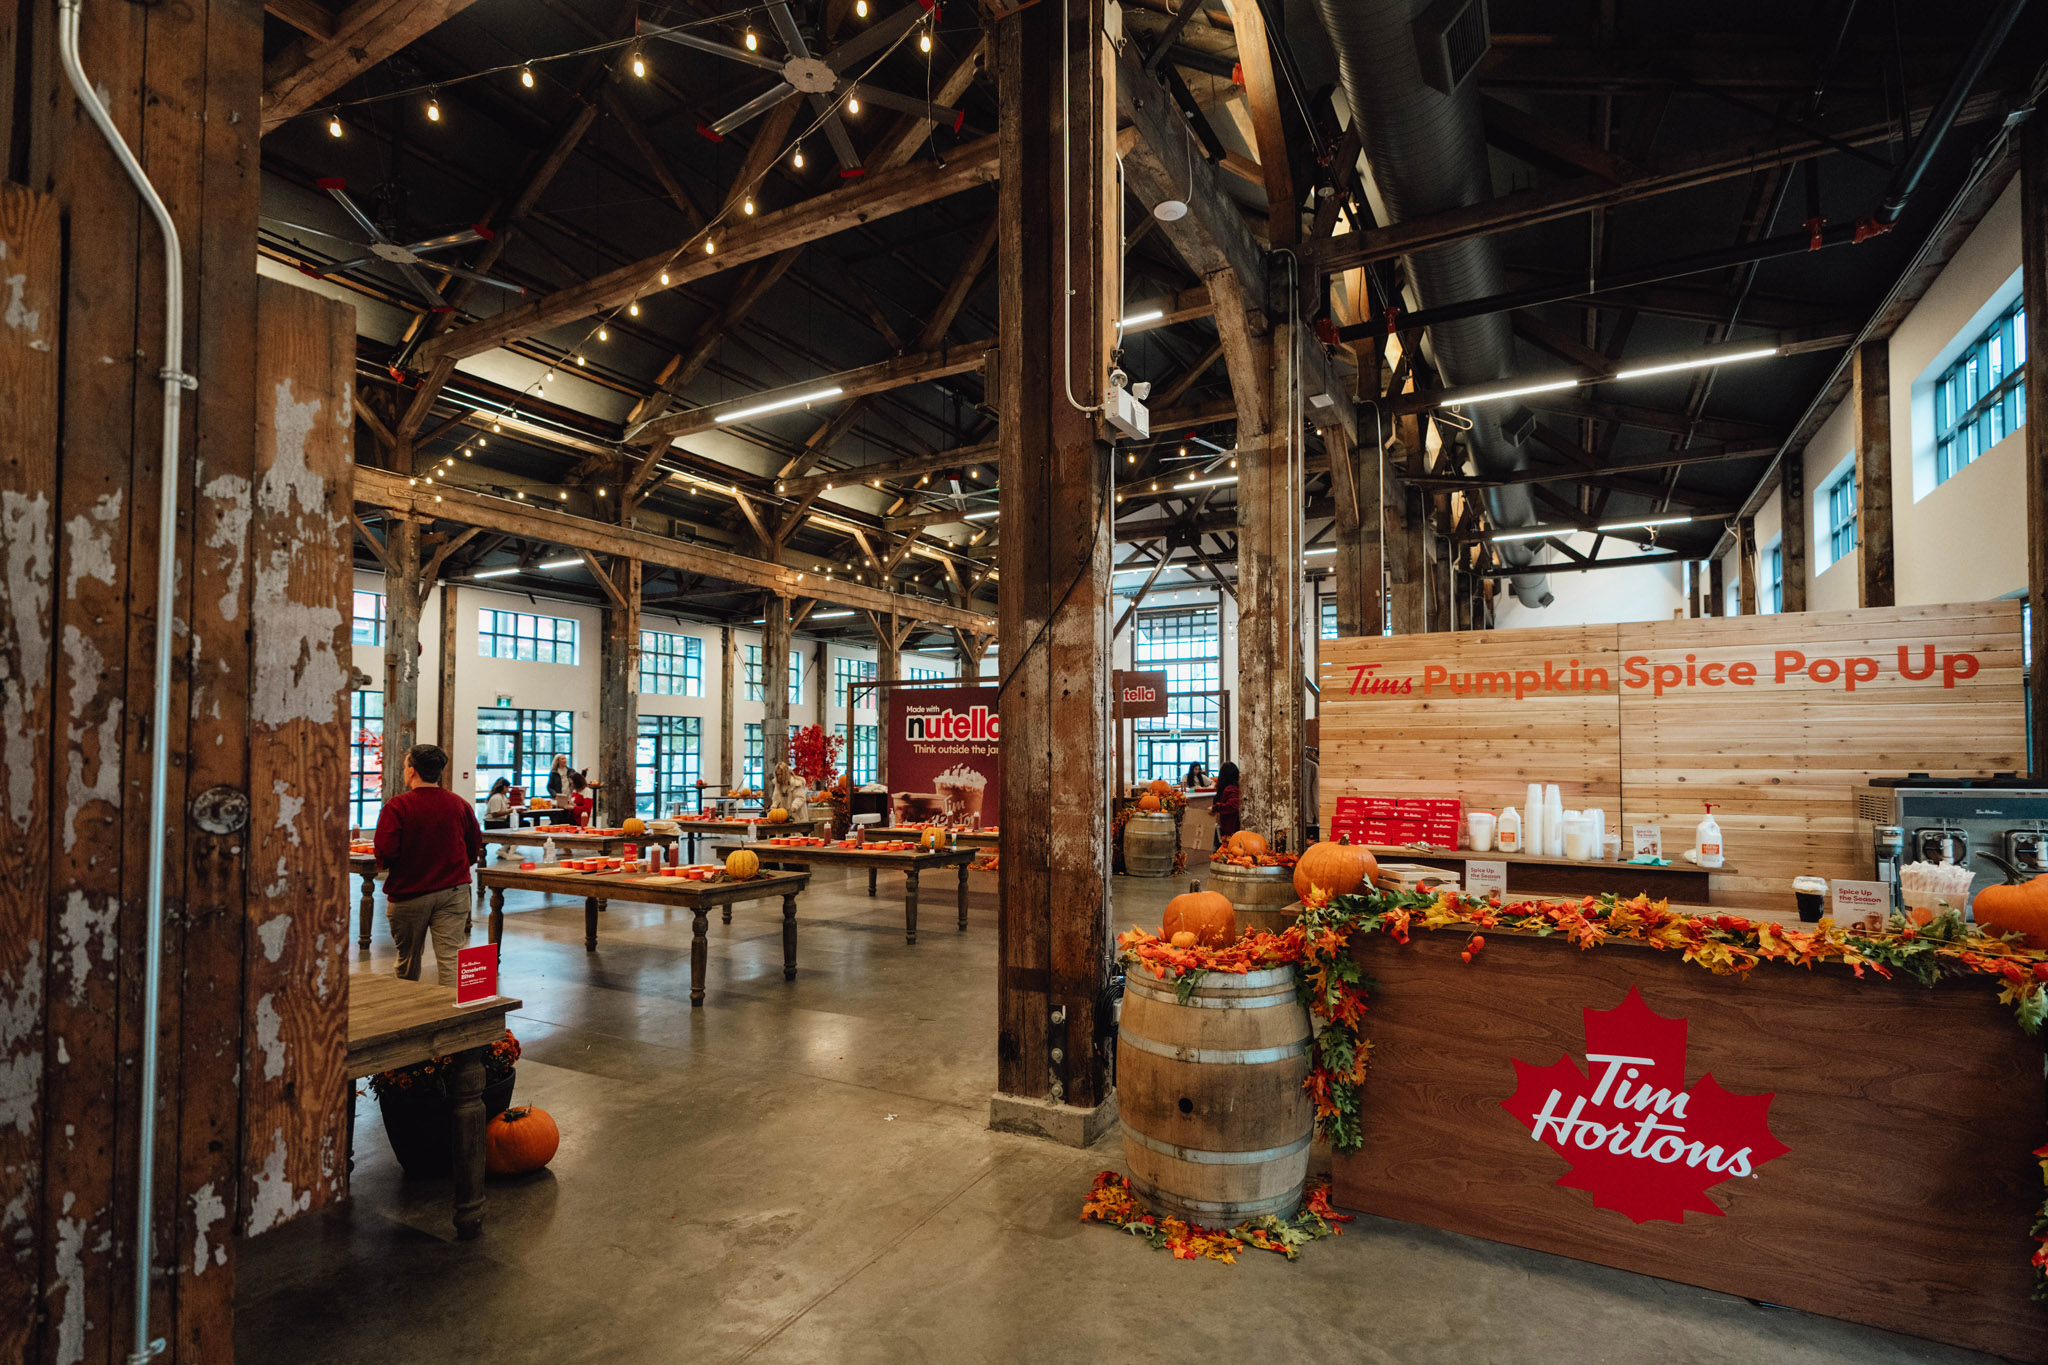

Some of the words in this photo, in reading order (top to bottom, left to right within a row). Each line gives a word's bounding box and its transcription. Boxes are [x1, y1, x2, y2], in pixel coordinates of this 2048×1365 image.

[1346, 664, 1412, 696] Tims
[1424, 659, 1609, 700] Pumpkin
[1624, 654, 1757, 696] Spice
[1775, 650, 1879, 691] Pop
[1897, 644, 1980, 689] Up
[1122, 686, 1155, 702] tella
[926, 705, 940, 713] with
[913, 744, 936, 754] Think
[938, 744, 970, 754] outside
[971, 745, 986, 754] the
[1853, 895, 1882, 903] Season
[1585, 1053, 1691, 1119] Tim
[1531, 1088, 1754, 1178] Hortons
